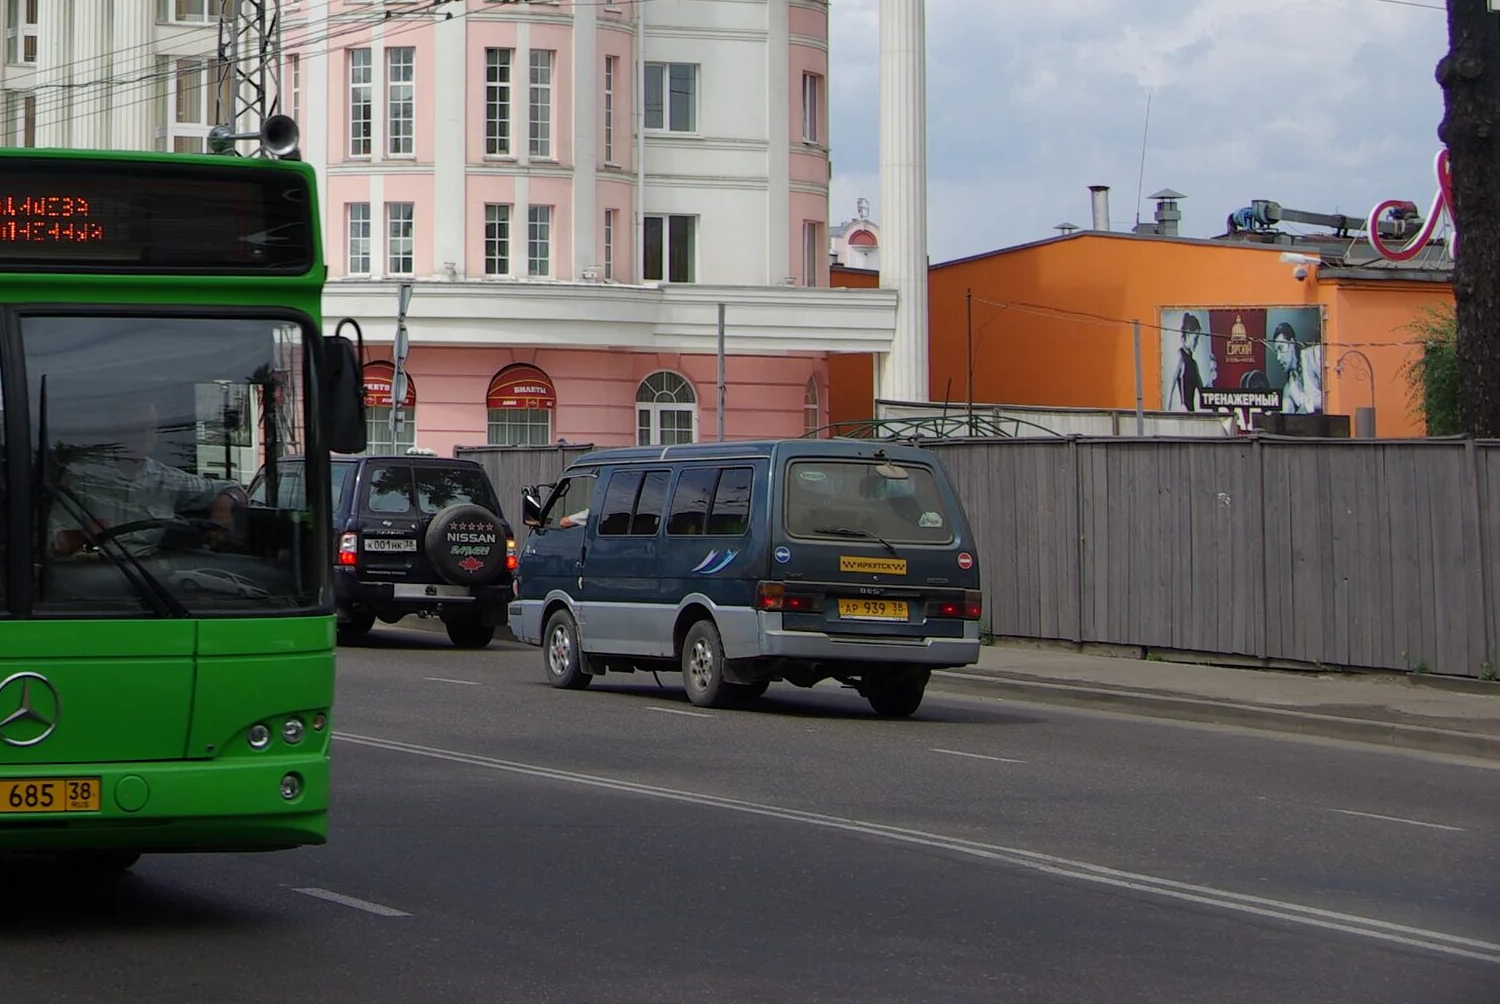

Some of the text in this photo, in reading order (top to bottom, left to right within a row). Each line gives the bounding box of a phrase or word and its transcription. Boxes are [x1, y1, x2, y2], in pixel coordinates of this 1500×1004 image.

[1202, 391, 1279, 406] ТРЕНАЖЕРНЫЙ
[447, 532, 496, 543] NISSAN
[857, 561, 892, 569] ИРКУТСК
[9, 784, 54, 808] 685
[68, 782, 91, 800] 38
